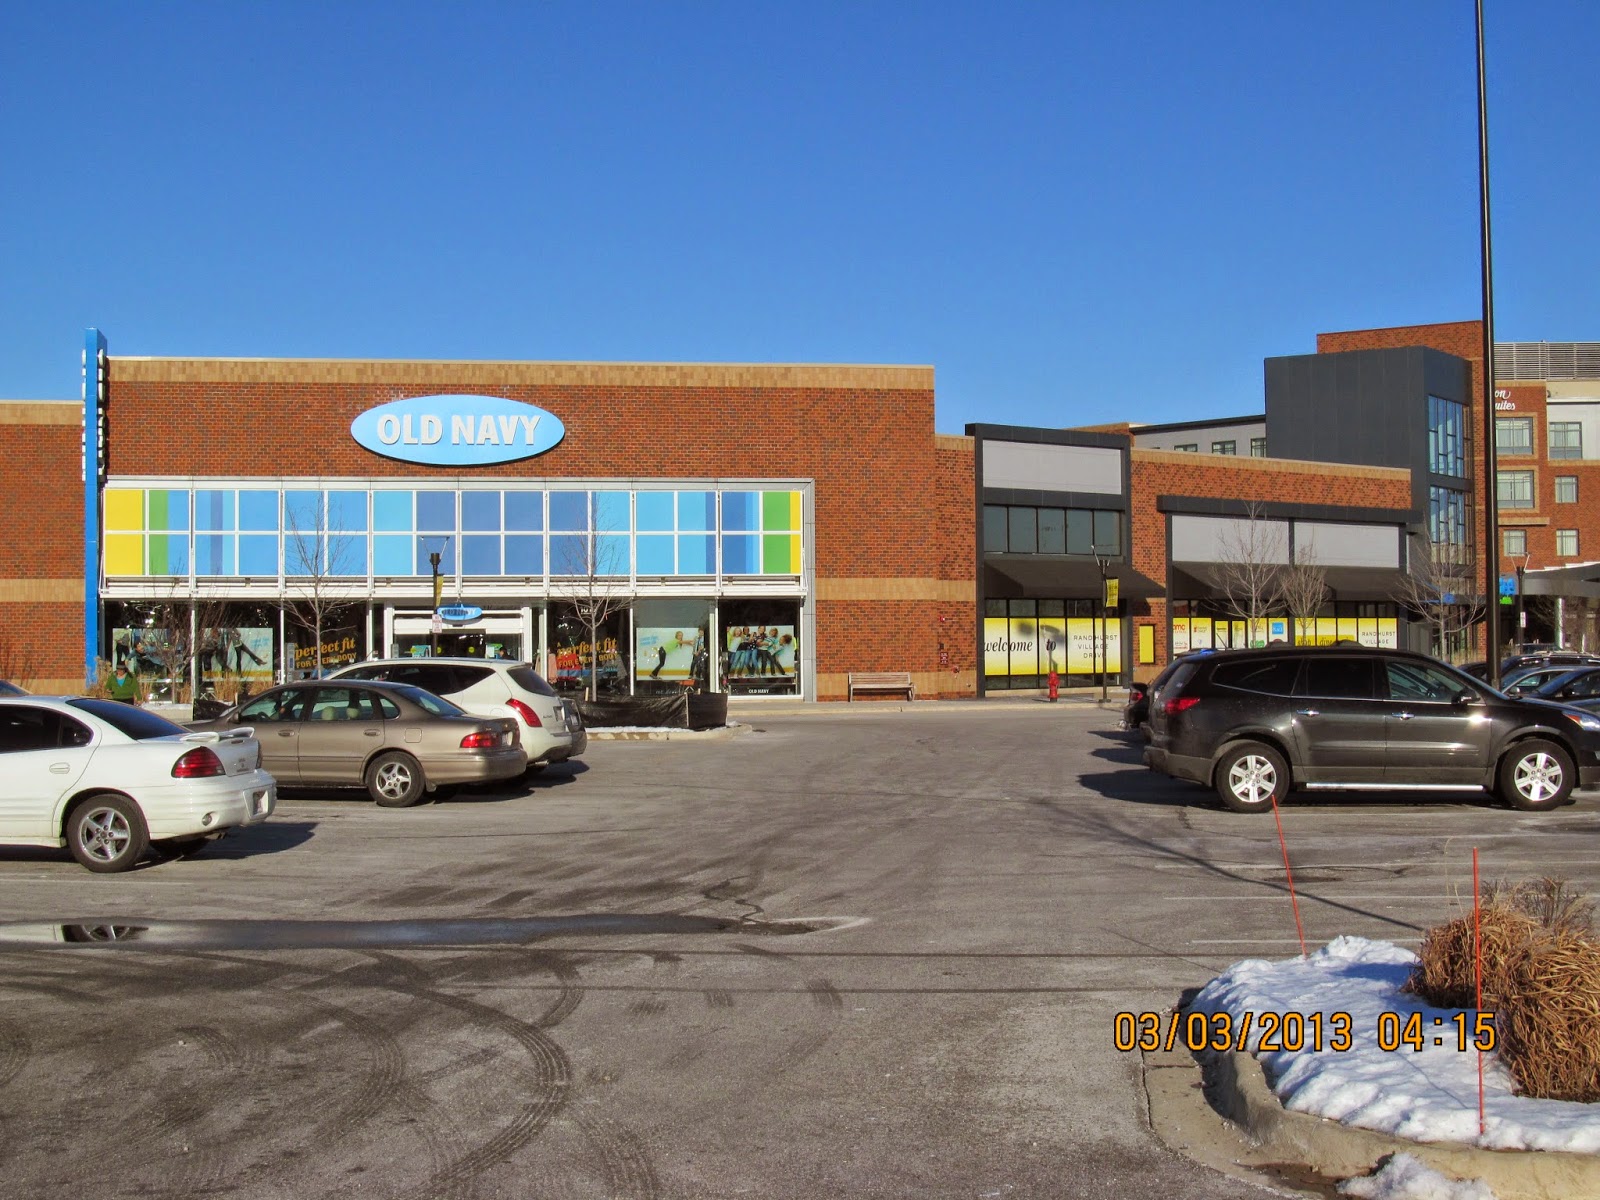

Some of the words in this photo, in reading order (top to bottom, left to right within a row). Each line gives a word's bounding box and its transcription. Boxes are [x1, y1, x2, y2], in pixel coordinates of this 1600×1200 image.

[1495, 400, 1516, 411] uites
[377, 414, 443, 446] OLD
[451, 414, 541, 446] NAVY
[295, 641, 339, 660] perect
[340, 637, 356, 653] fit
[603, 637, 617, 653] fit
[984, 637, 1033, 652] welcome
[1046, 638, 1057, 652] to
[296, 660, 311, 669] FOR
[599, 652, 618, 662] BODY
